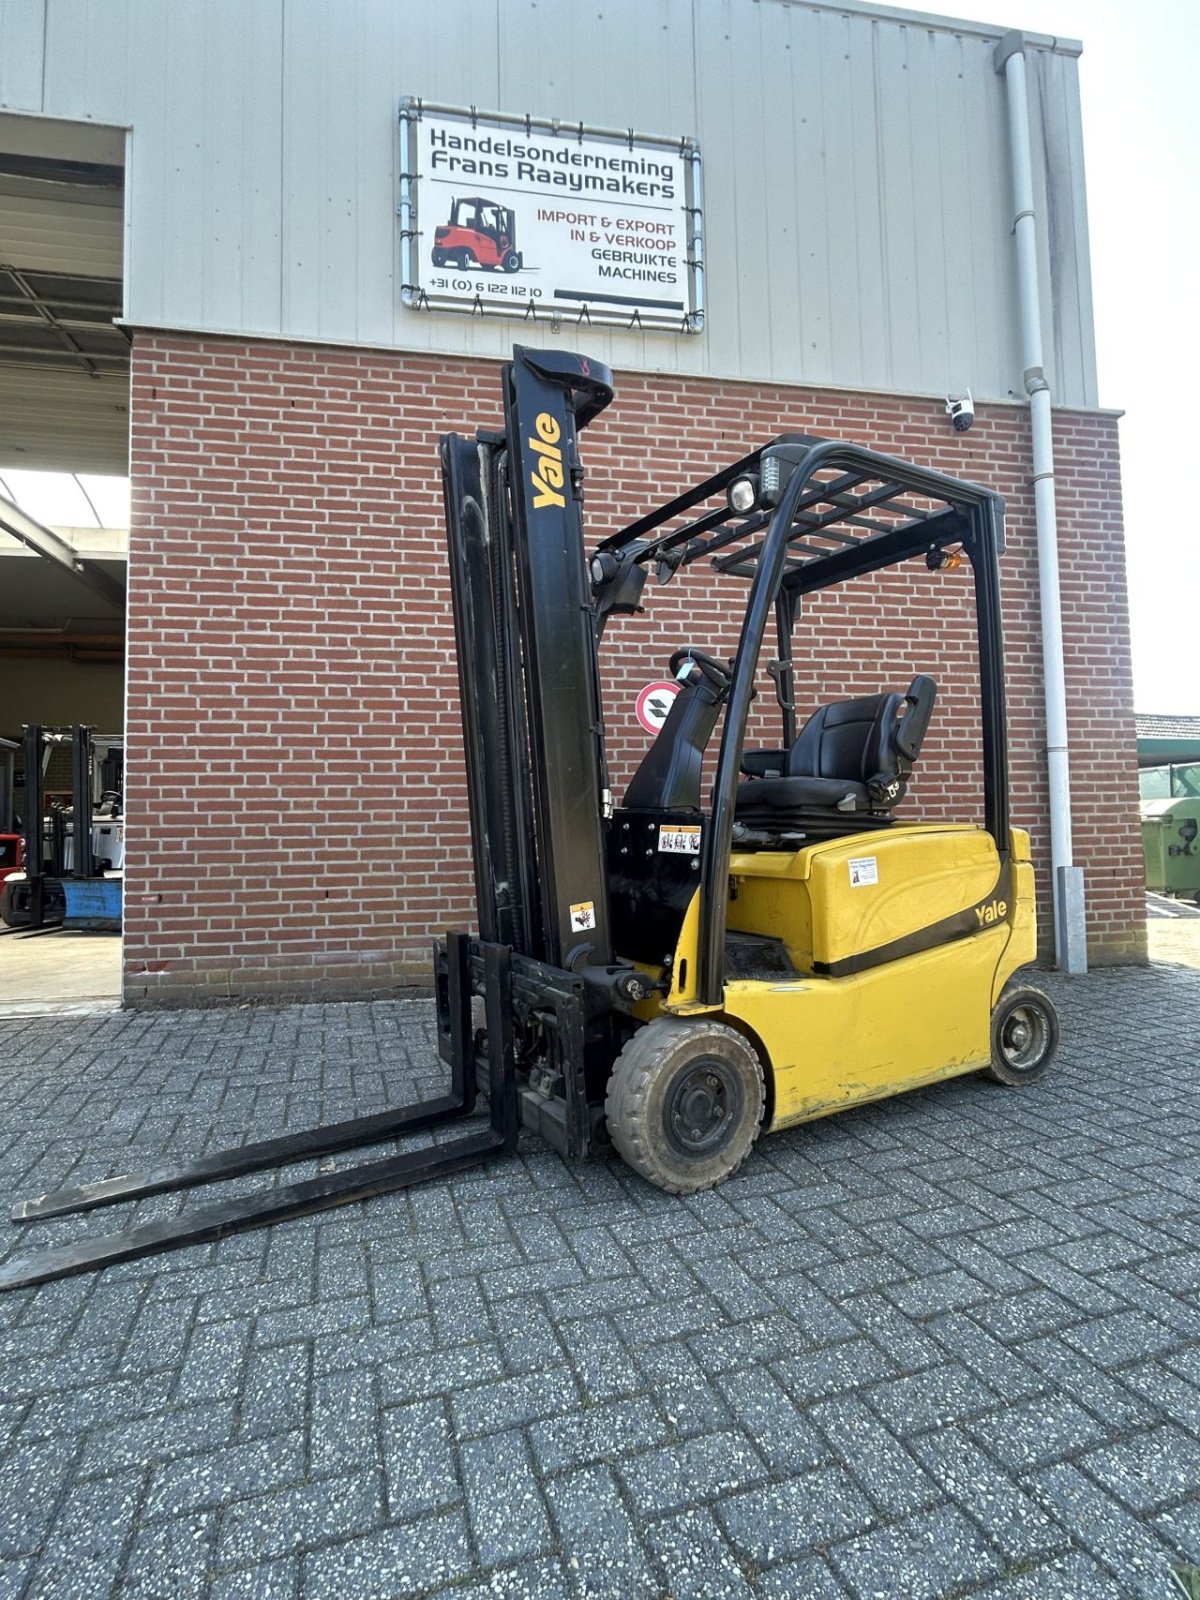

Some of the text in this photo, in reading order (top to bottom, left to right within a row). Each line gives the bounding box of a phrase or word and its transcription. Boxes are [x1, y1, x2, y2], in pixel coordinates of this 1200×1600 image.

[430, 128, 674, 182] Handelsonderneming
[431, 150, 675, 199] Frans Raaymakers
[537, 209, 676, 236] IMPORT & EXPORT
[570, 229, 677, 252] IN & VERKOOP
[591, 248, 677, 268] GEBRUIKTE
[598, 264, 678, 284] MACHINES
[429, 278, 543, 298] +31 (0) 6 122 112 10
[528, 412, 566, 509] Yale
[975, 899, 1008, 926] Yale
